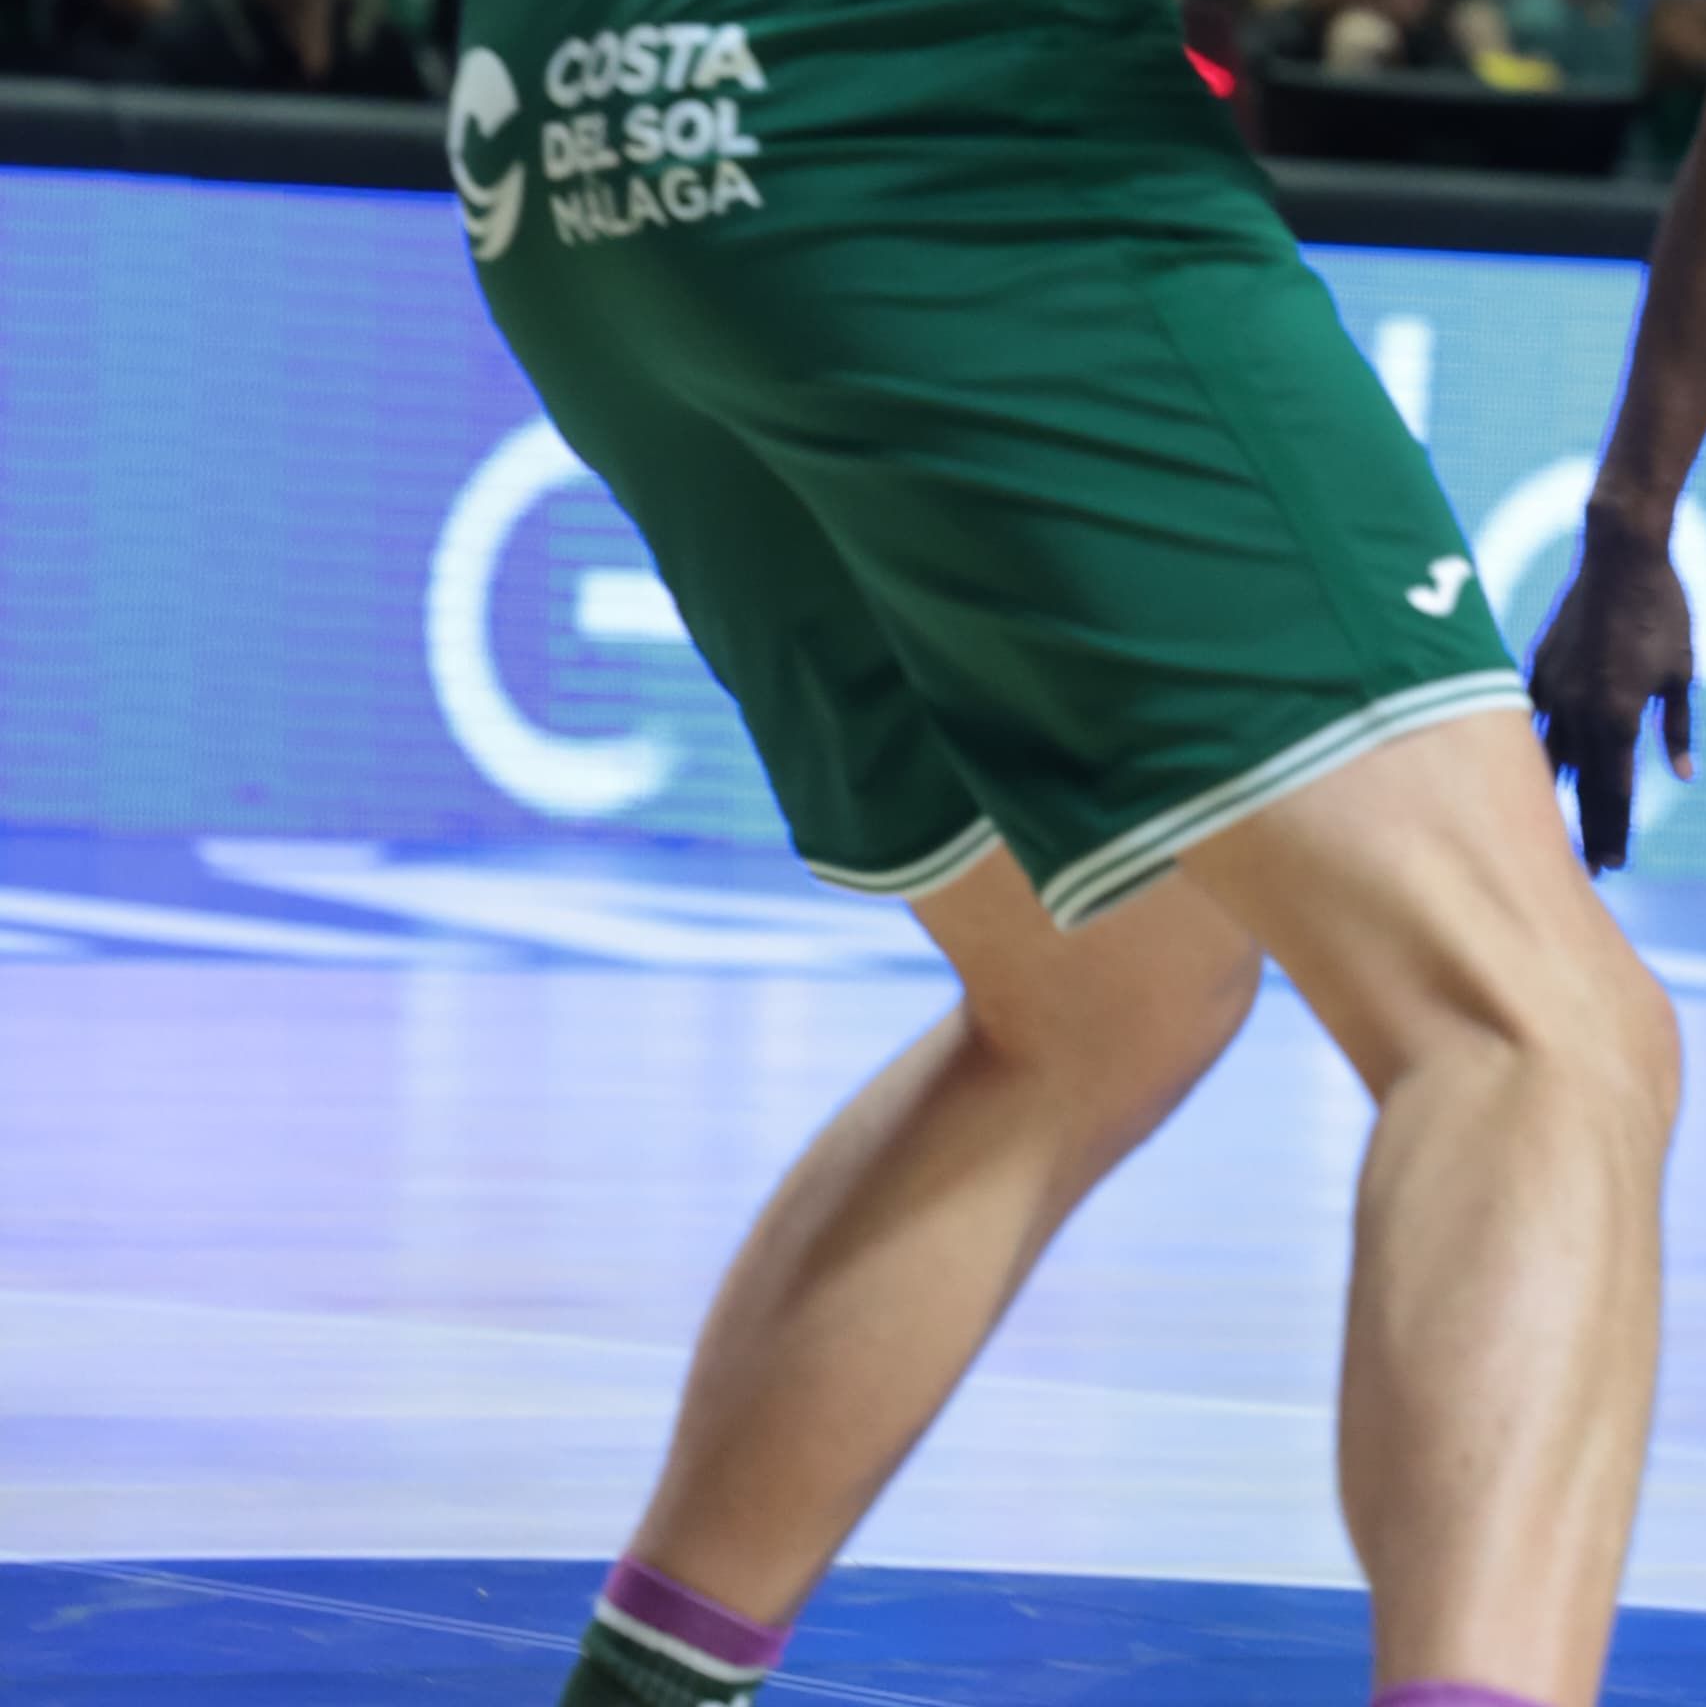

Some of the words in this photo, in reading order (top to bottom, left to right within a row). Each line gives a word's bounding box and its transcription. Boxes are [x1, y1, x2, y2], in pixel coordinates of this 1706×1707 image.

[545, 22, 767, 109] COSTA
[542, 112, 620, 182] DEL
[623, 98, 760, 163] SOL
